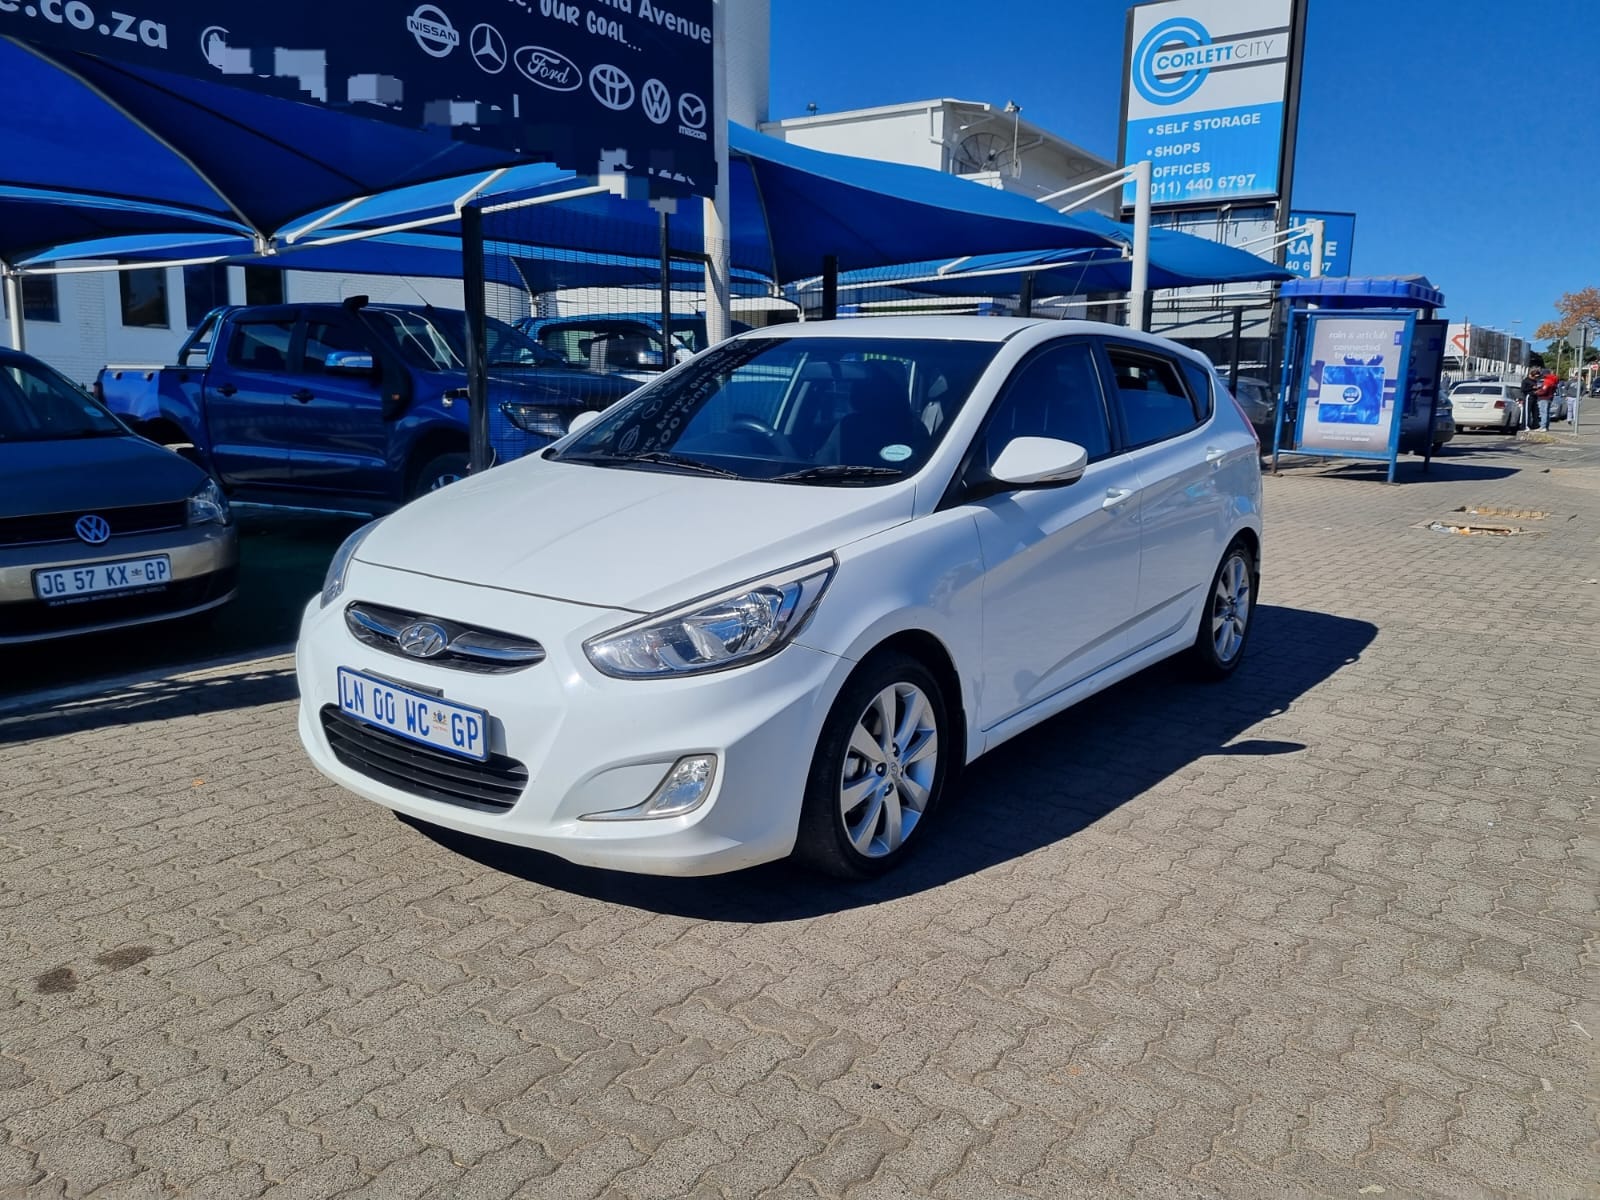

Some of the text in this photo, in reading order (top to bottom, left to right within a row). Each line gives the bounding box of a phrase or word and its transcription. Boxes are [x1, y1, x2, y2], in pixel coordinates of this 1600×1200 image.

[540, 0, 581, 27] OUR
[638, 0, 712, 44] Avenue
[410, 20, 457, 42] NISSAN
[527, 51, 570, 84] Ford
[1155, 113, 1261, 136] SELF STORAGE
[1154, 142, 1201, 157] SHOPS
[1153, 162, 1211, 178] OFFICES
[1151, 173, 1256, 196] 011) 440 6797
[1287, 240, 1338, 256] RAE
[1302, 261, 1332, 272] 67
[42, 560, 166, 595] JG 57 KX GP
[343, 676, 365, 714] LN
[405, 698, 430, 737] WC
[451, 712, 479, 751] GP
